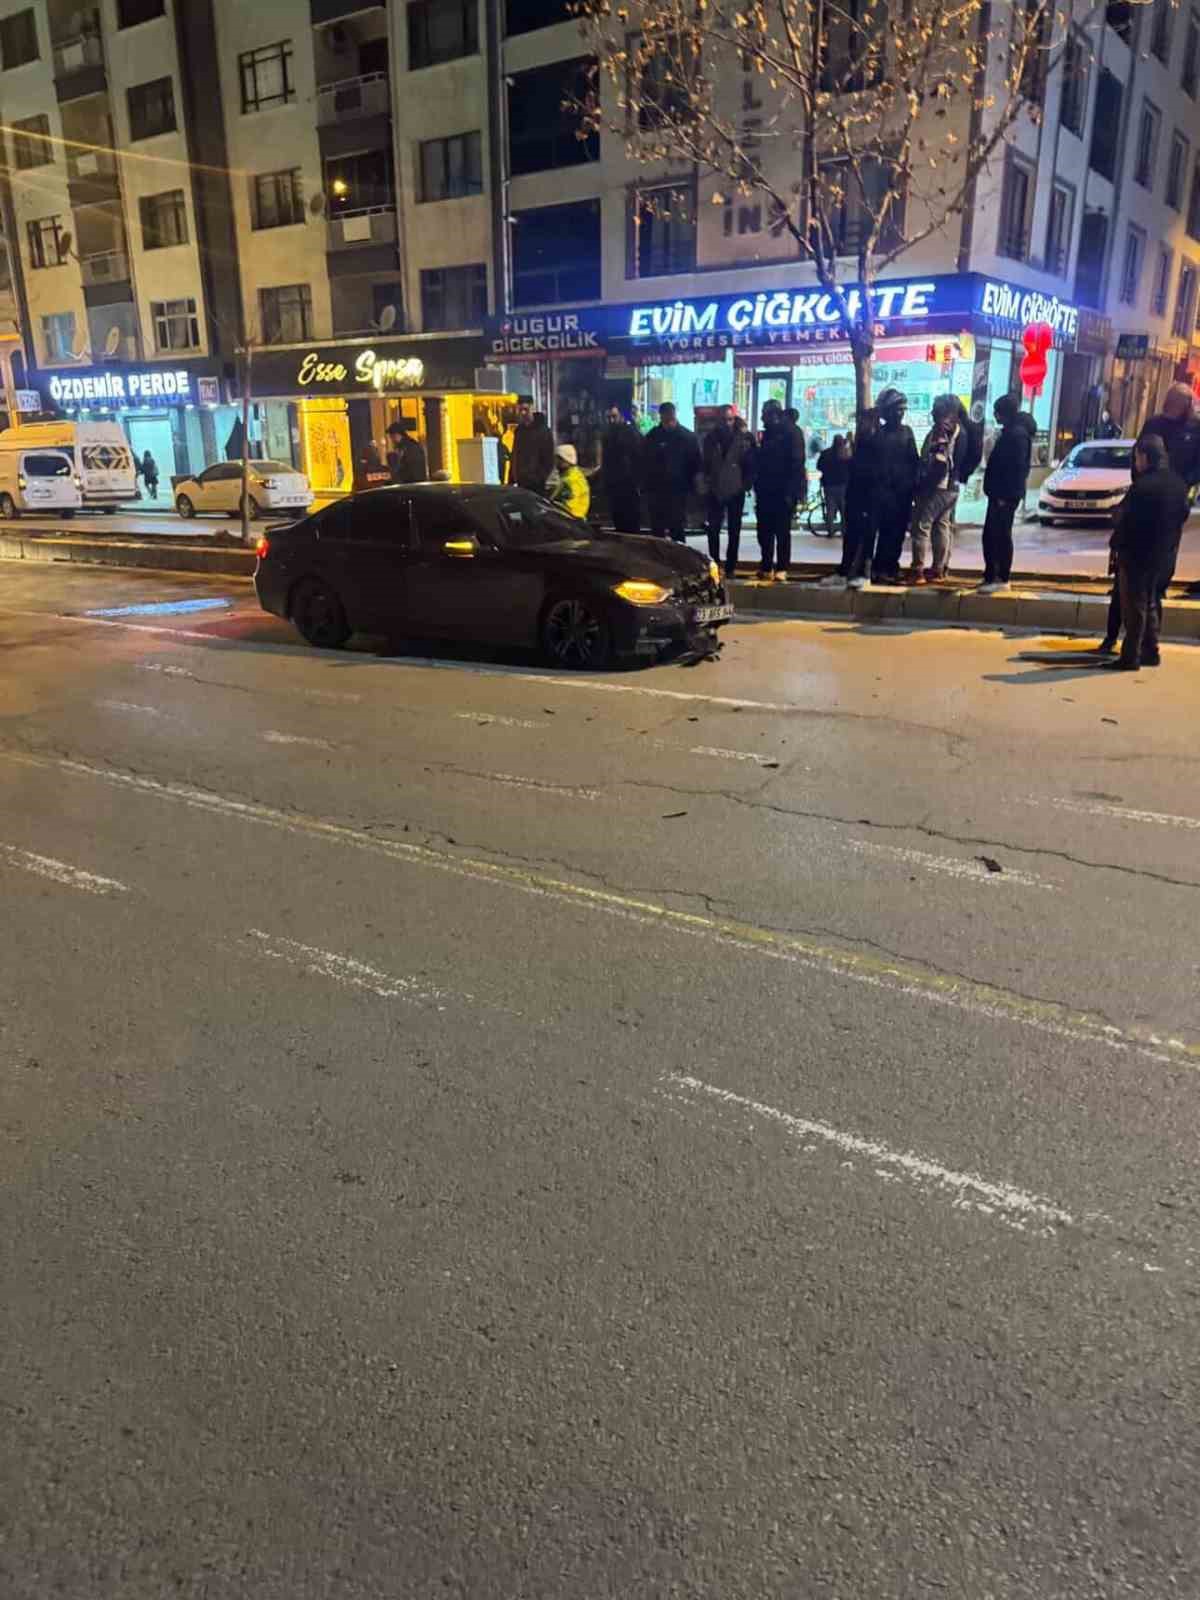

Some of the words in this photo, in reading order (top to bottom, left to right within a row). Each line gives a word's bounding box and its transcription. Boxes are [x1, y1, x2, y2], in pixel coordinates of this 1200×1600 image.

[630, 301, 719, 336] EVİM
[982, 282, 1021, 320] EVİM
[50, 373, 125, 401] ÖZDEMİR
[128, 371, 190, 396] PERDE
